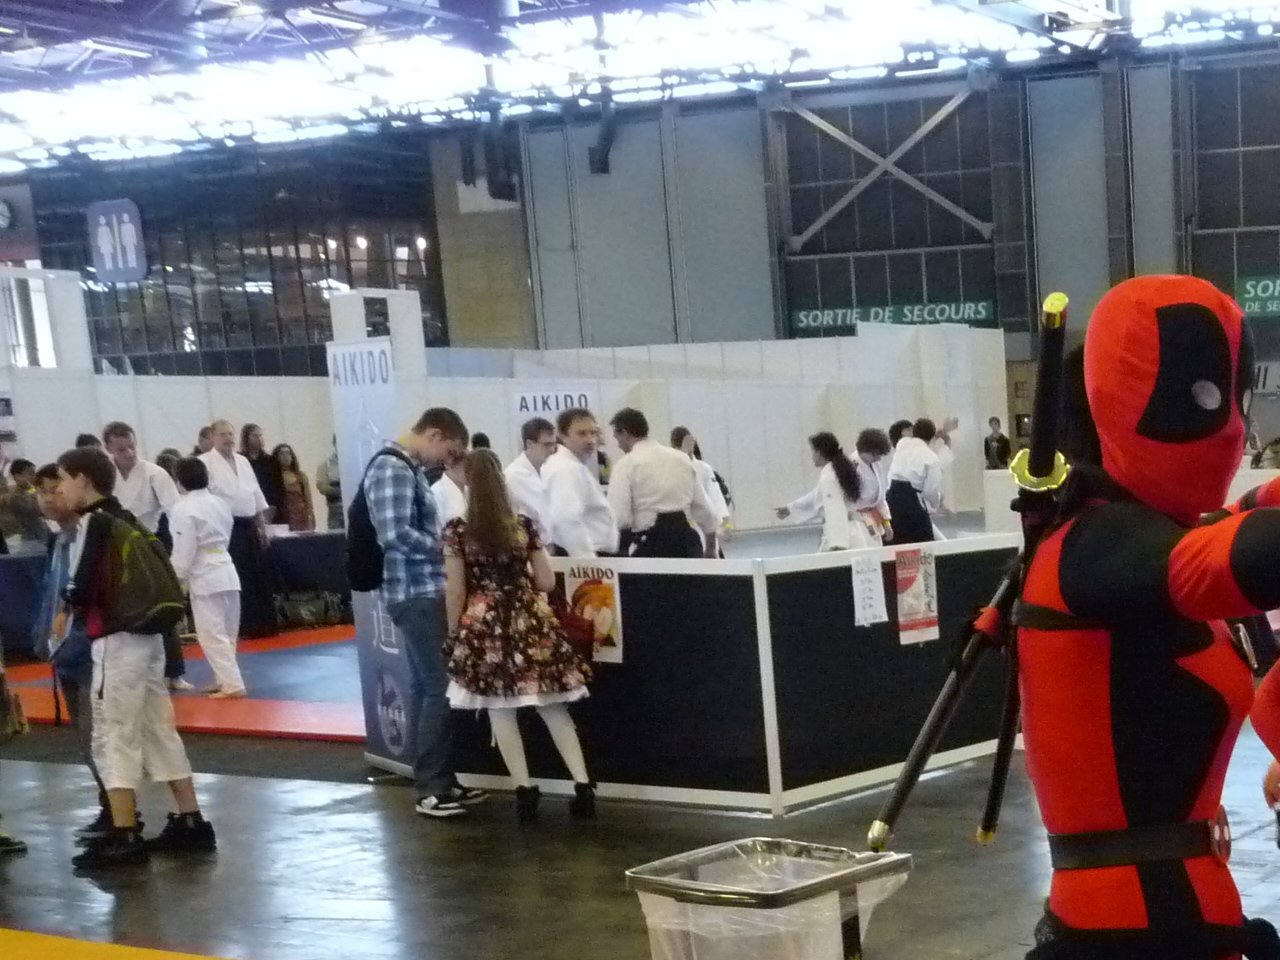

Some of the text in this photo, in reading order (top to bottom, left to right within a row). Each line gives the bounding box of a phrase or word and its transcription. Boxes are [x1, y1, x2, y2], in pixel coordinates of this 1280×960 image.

[798, 302, 987, 328] SORTIE DE SECOURS
[1245, 302, 1261, 312] DE
[333, 349, 389, 386] AIKIDO
[519, 393, 589, 412] AIKIDO
